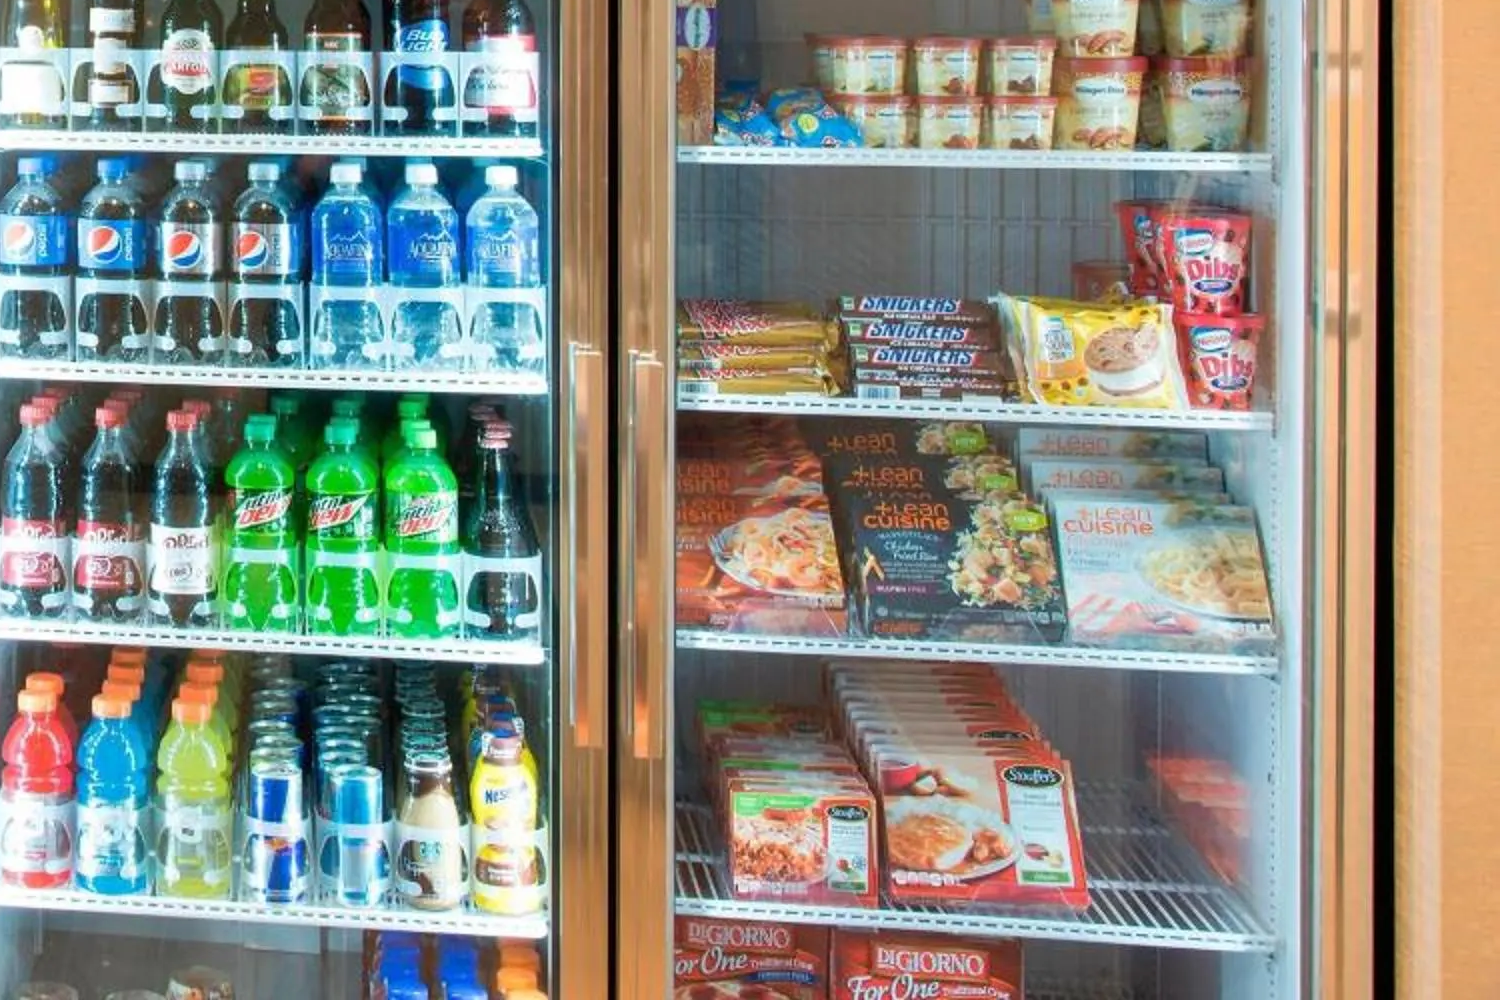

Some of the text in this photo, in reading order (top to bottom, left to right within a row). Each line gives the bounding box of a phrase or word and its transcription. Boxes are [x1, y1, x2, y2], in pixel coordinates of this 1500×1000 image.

[1186, 255, 1240, 281] Dibs
[863, 297, 958, 313] SNICKERS
[870, 323, 965, 340] SNICKERS
[877, 349, 973, 366] SNICKERS
[1199, 351, 1253, 378] Dibs
[894, 502, 949, 516] Lean
[1010, 767, 1058, 785] Stouffer's
[700, 946, 747, 974] One
[847, 975, 889, 1000] For
[890, 973, 940, 1000] One
